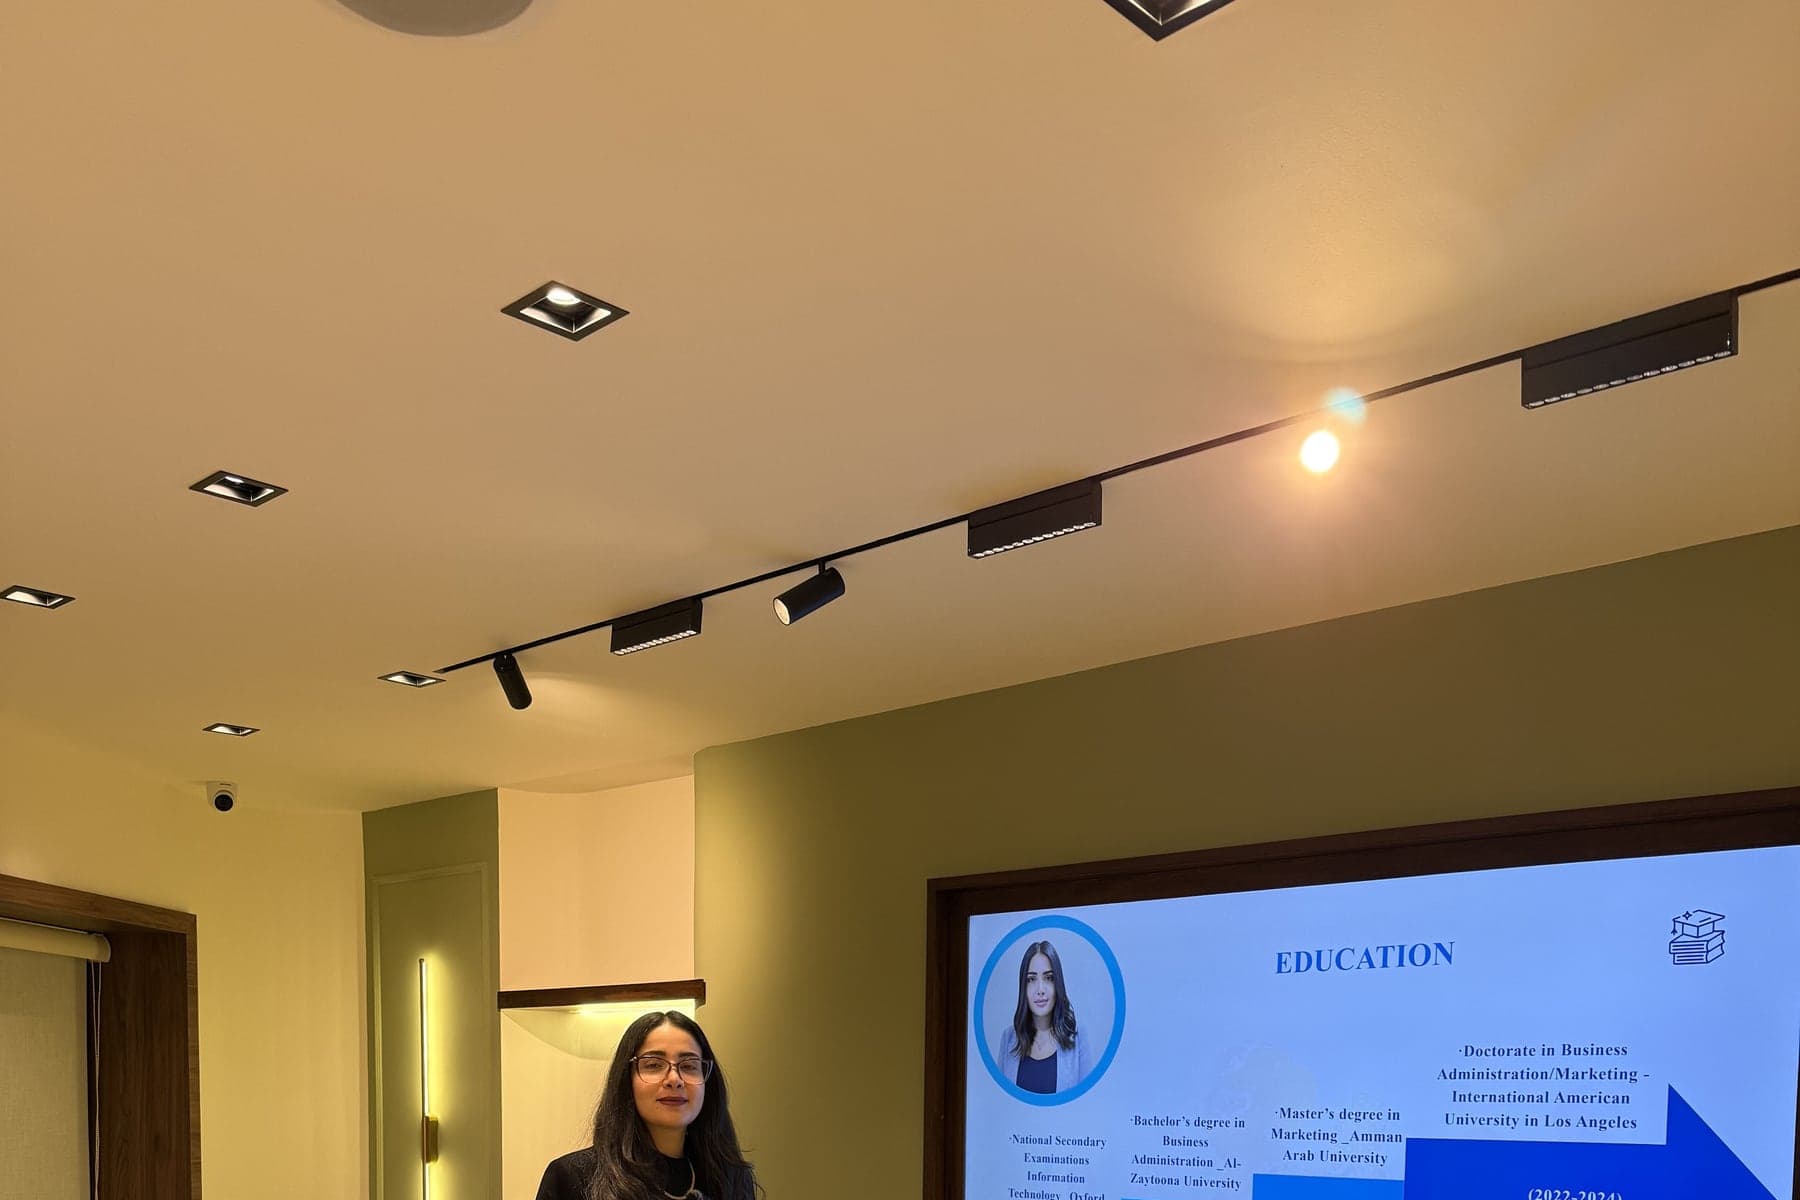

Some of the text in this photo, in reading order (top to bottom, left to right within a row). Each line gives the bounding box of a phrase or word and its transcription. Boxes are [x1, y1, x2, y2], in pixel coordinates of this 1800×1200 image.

[1275, 941, 1456, 975] EDUCATION
[1541, 1043, 1555, 1057] in
[1561, 1043, 1628, 1056] Business
[1452, 1090, 1630, 1105] International American
[1339, 1107, 1383, 1124] degree
[1387, 1108, 1400, 1121] in
[1445, 1112, 1637, 1132] University in Los Angeles
[1193, 1116, 1231, 1131] degree
[1234, 1116, 1245, 1129] in
[1054, 1135, 1107, 1150] Secondary
[1162, 1135, 1209, 1148] Business
[1271, 1127, 1338, 1145] Marketing
[1024, 1152, 1090, 1166] Examinations
[1131, 1154, 1213, 1168] Administration
[1282, 1149, 1388, 1168] Arab University
[1027, 1170, 1085, 1185] Information
[1130, 1172, 1242, 1192] Zaytoona University
